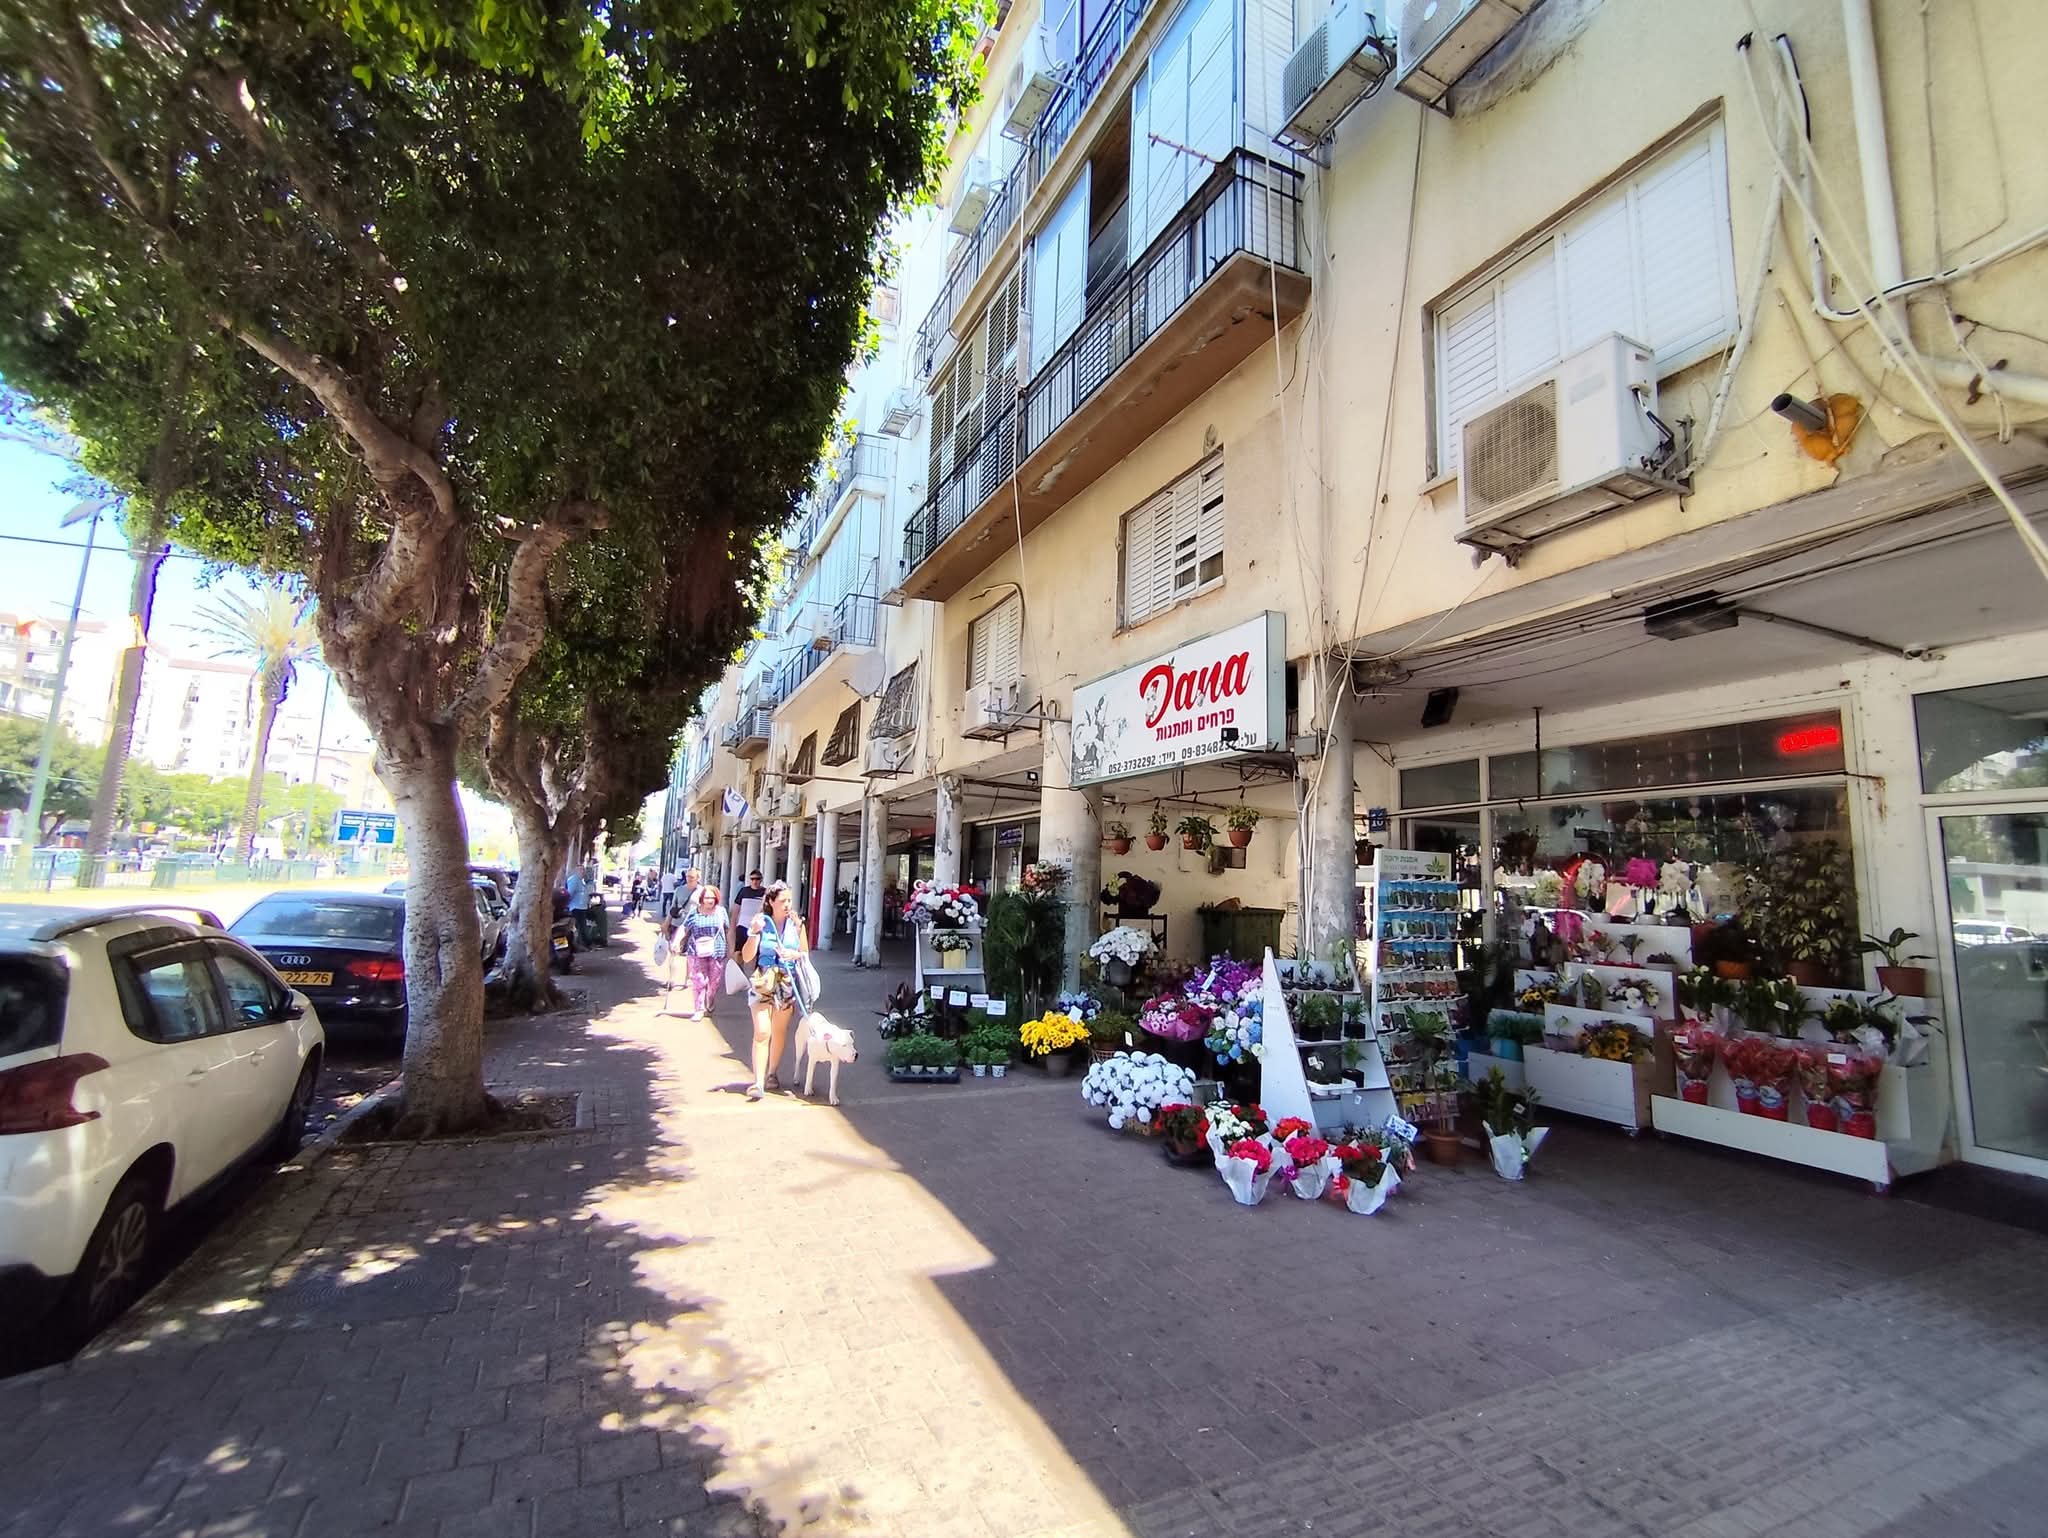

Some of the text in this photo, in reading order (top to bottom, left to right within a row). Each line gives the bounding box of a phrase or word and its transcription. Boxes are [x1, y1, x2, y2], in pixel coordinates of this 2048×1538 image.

[1139, 651, 1252, 729] Dana
[1156, 708, 1235, 741] פרחים ומתנות
[1181, 738, 1237, 759] 09-834822
[1240, 732, 1257, 748] טל:
[1108, 755, 1156, 774] 052-3732292
[1158, 751, 1176, 764] נייד:
